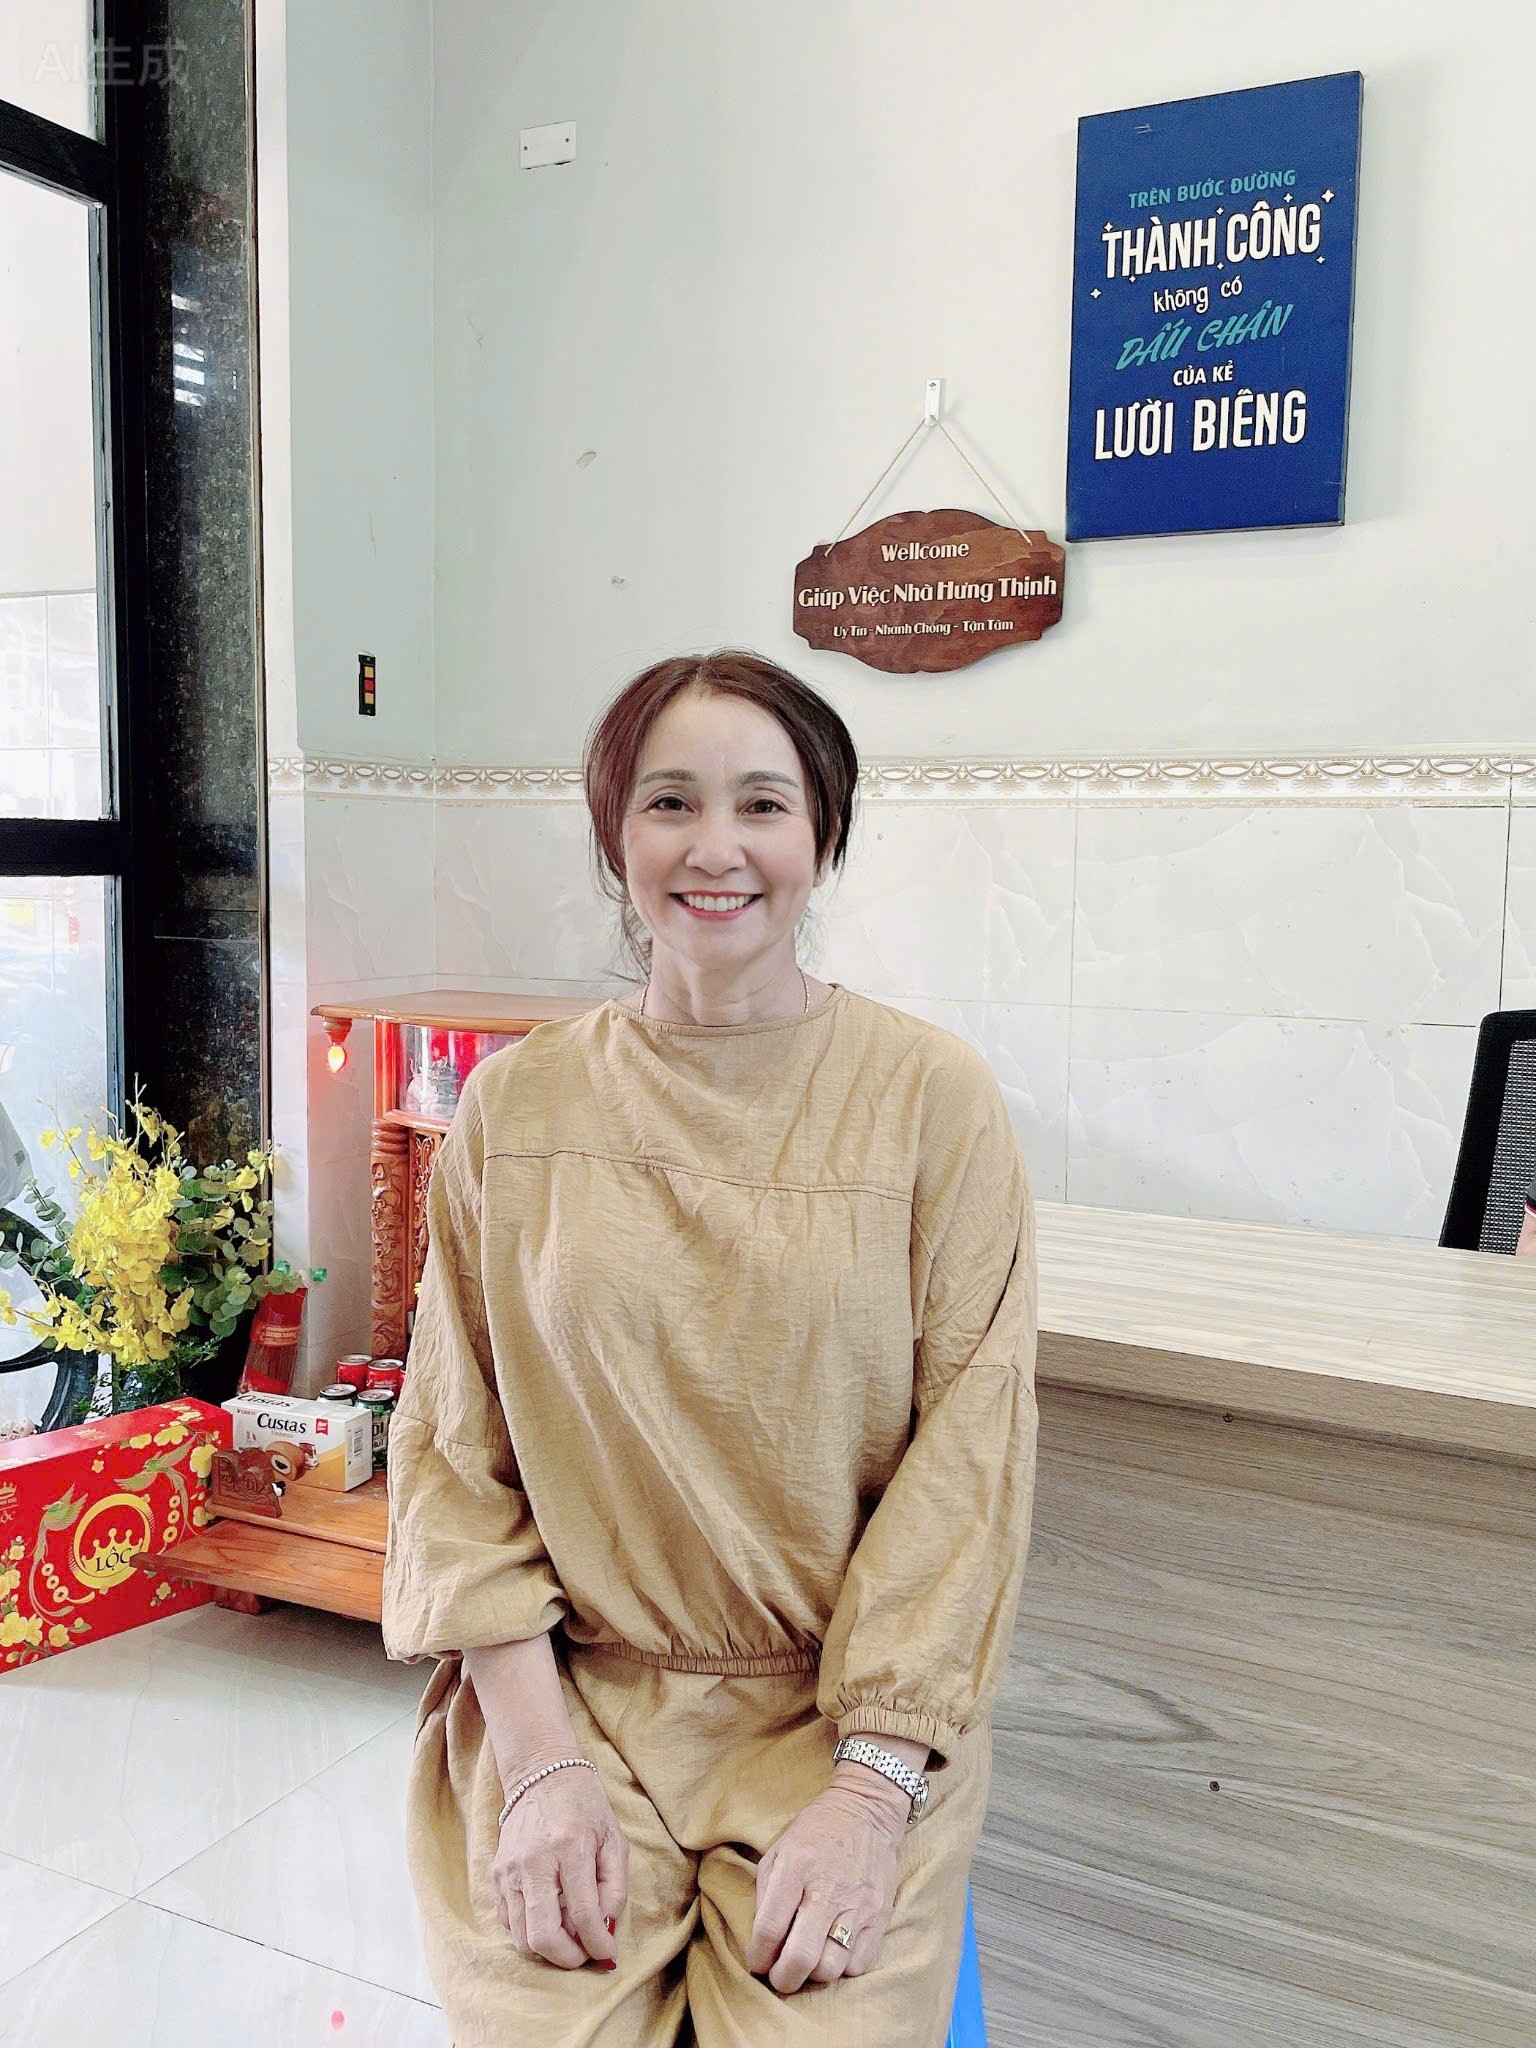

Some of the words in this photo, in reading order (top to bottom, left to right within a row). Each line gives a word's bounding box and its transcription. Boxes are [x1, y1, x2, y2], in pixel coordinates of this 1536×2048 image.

[1128, 187, 1171, 209] TRÊN
[1177, 178, 1224, 202] BƯỚC
[1230, 169, 1296, 194] ĐƯỜNG
[1102, 215, 1217, 279] THÀNH
[1226, 200, 1321, 263] CÔNG
[1153, 285, 1208, 314] không
[1220, 274, 1243, 297] có
[1115, 318, 1192, 370] DẤU
[1197, 299, 1294, 352] CHÂN
[1172, 364, 1207, 386] CỦA
[1212, 359, 1234, 382] KẺ
[1095, 398, 1174, 460] LƯỜI
[1192, 388, 1307, 452] BIẾNG
[881, 542, 970, 562] Wellcome
[798, 587, 845, 610] Giúp
[848, 585, 891, 606] Việc
[893, 583, 933, 603] Nhà
[936, 580, 994, 603] Hưng
[998, 575, 1057, 600] Thịnh
[833, 626, 848, 640] Uy
[875, 623, 912, 636] Nhanh
[962, 620, 985, 633] Tận
[257, 1413, 307, 1434] Custas
[96, 1546, 132, 1572] LỘC
